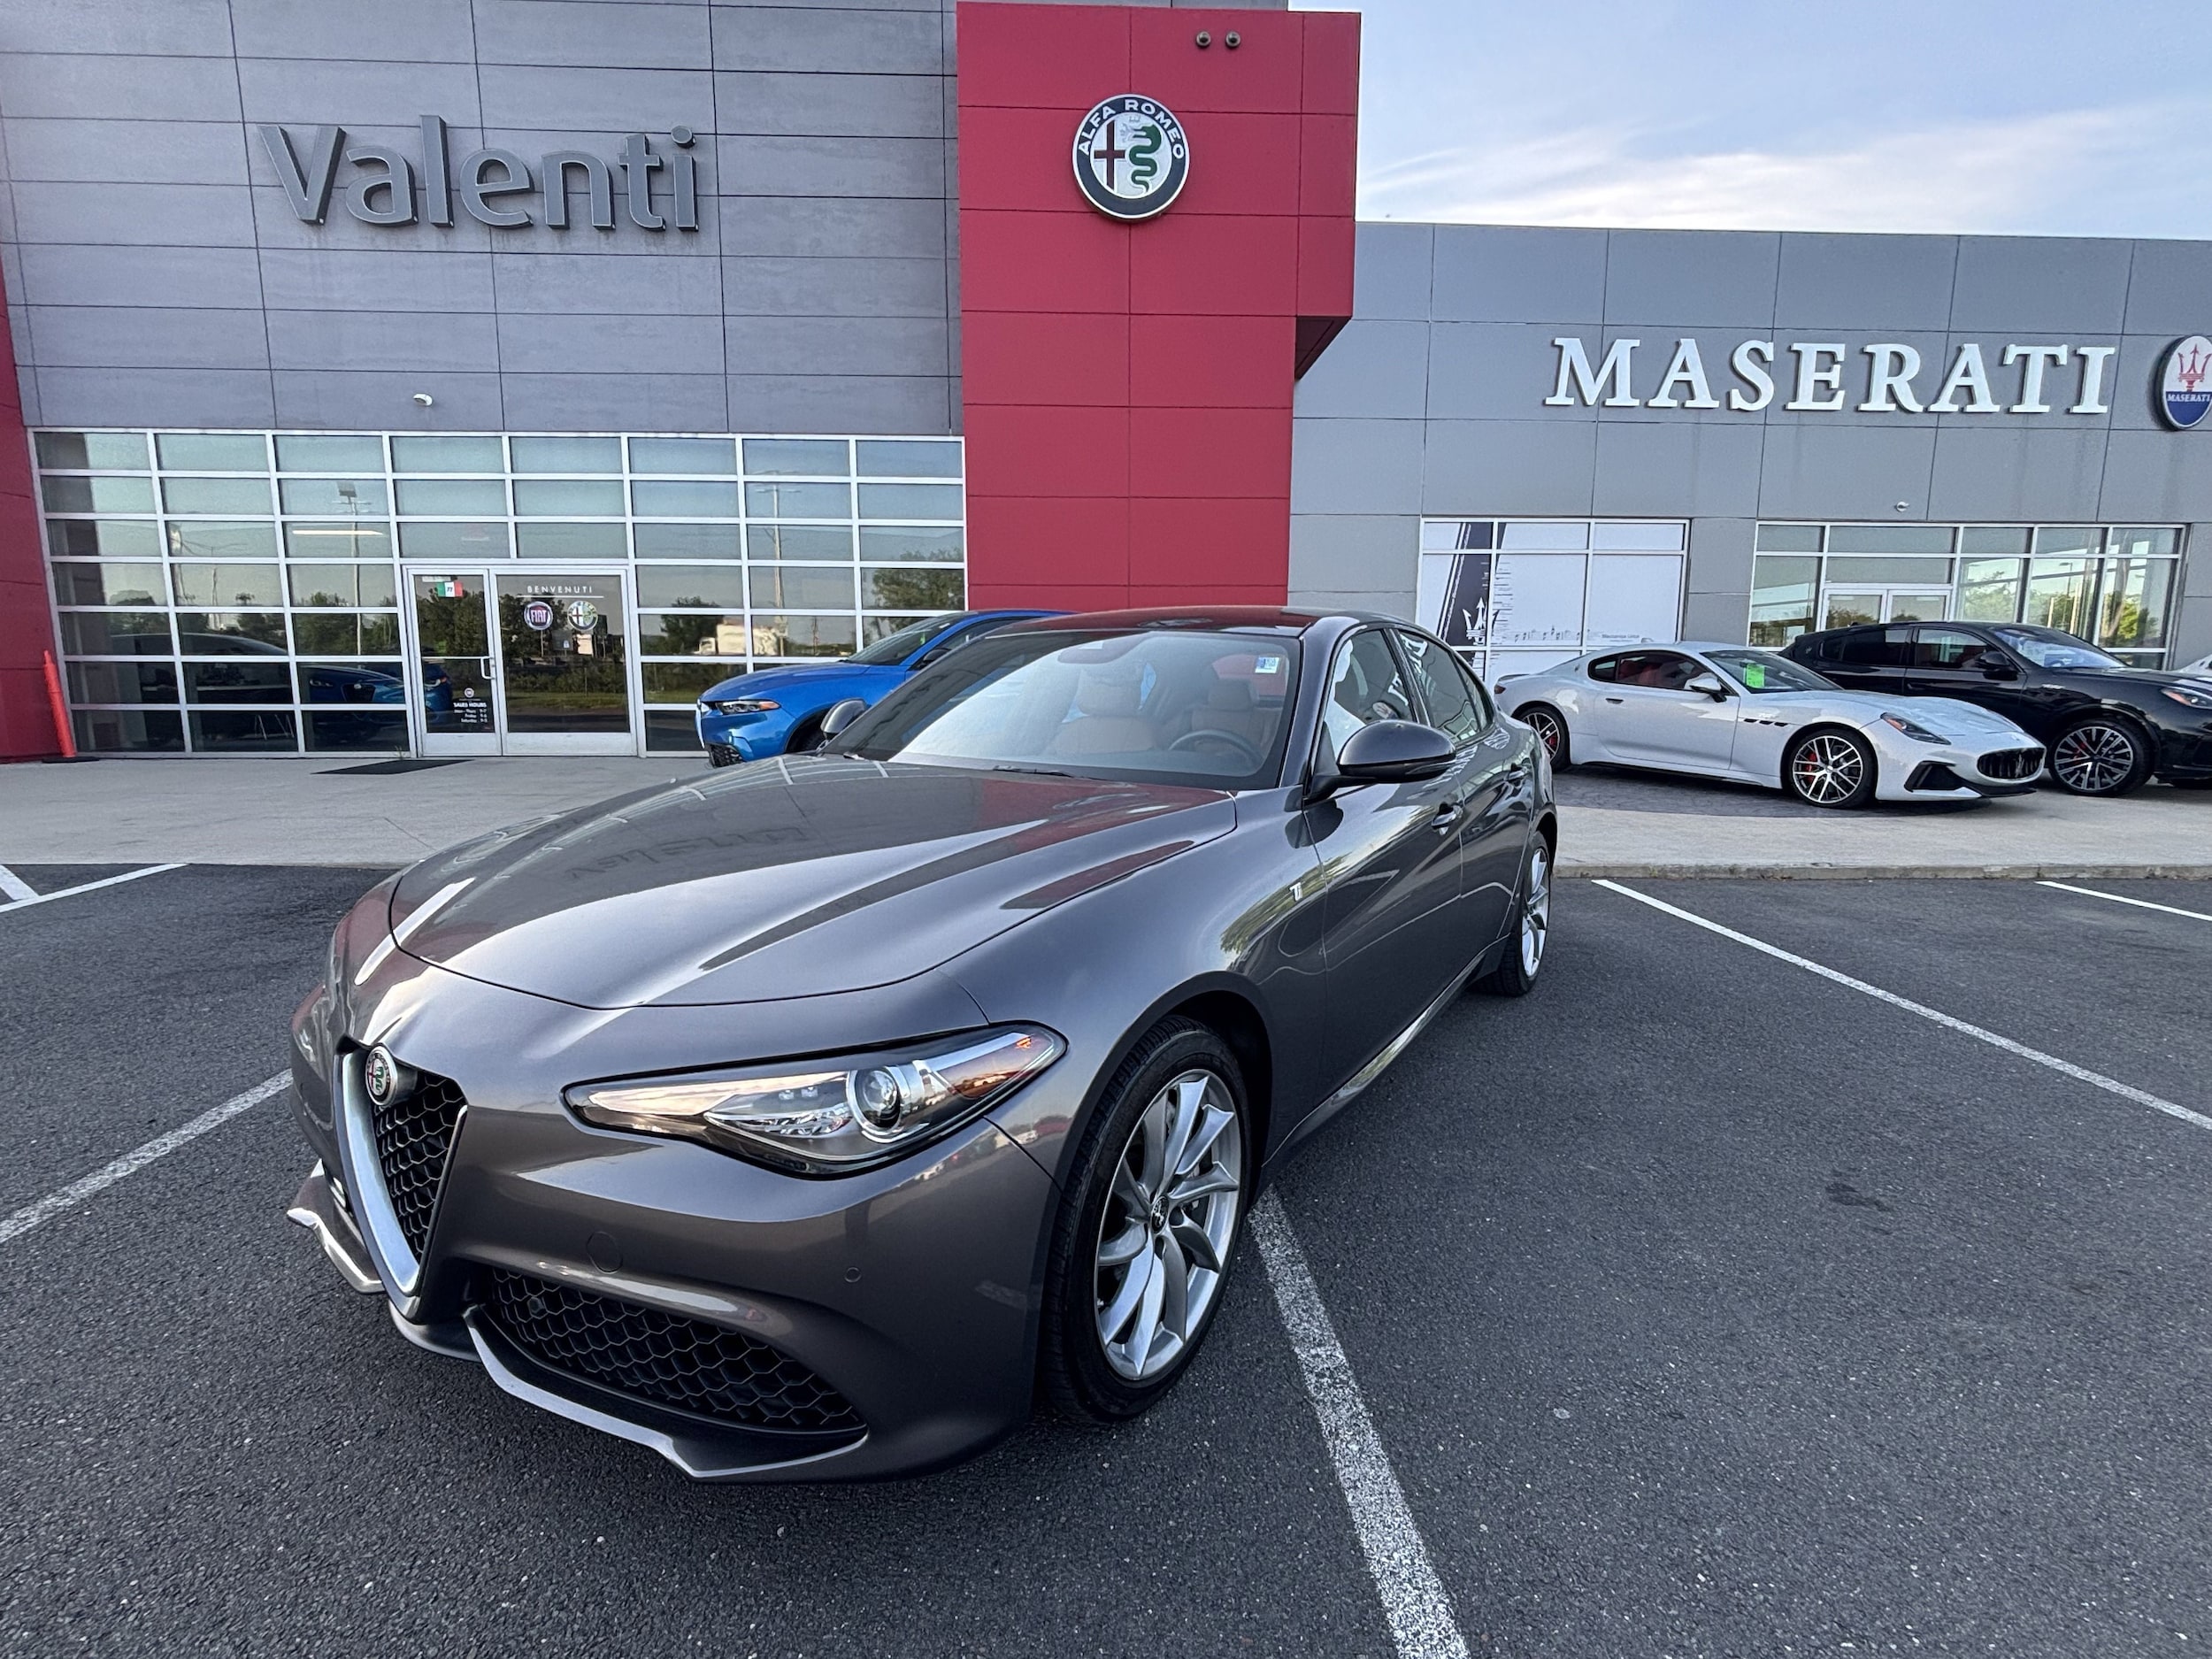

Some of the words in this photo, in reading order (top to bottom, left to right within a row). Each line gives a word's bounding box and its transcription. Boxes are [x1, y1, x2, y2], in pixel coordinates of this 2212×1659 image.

[1078, 104, 1117, 156] ALFA
[1125, 98, 1185, 159] ROMEO
[257, 115, 699, 231] Valenti
[1546, 337, 2116, 414] MASERATI
[2167, 393, 2211, 403] MASERATI
[526, 585, 593, 594] BENVENUTI
[531, 609, 548, 623] FIAT
